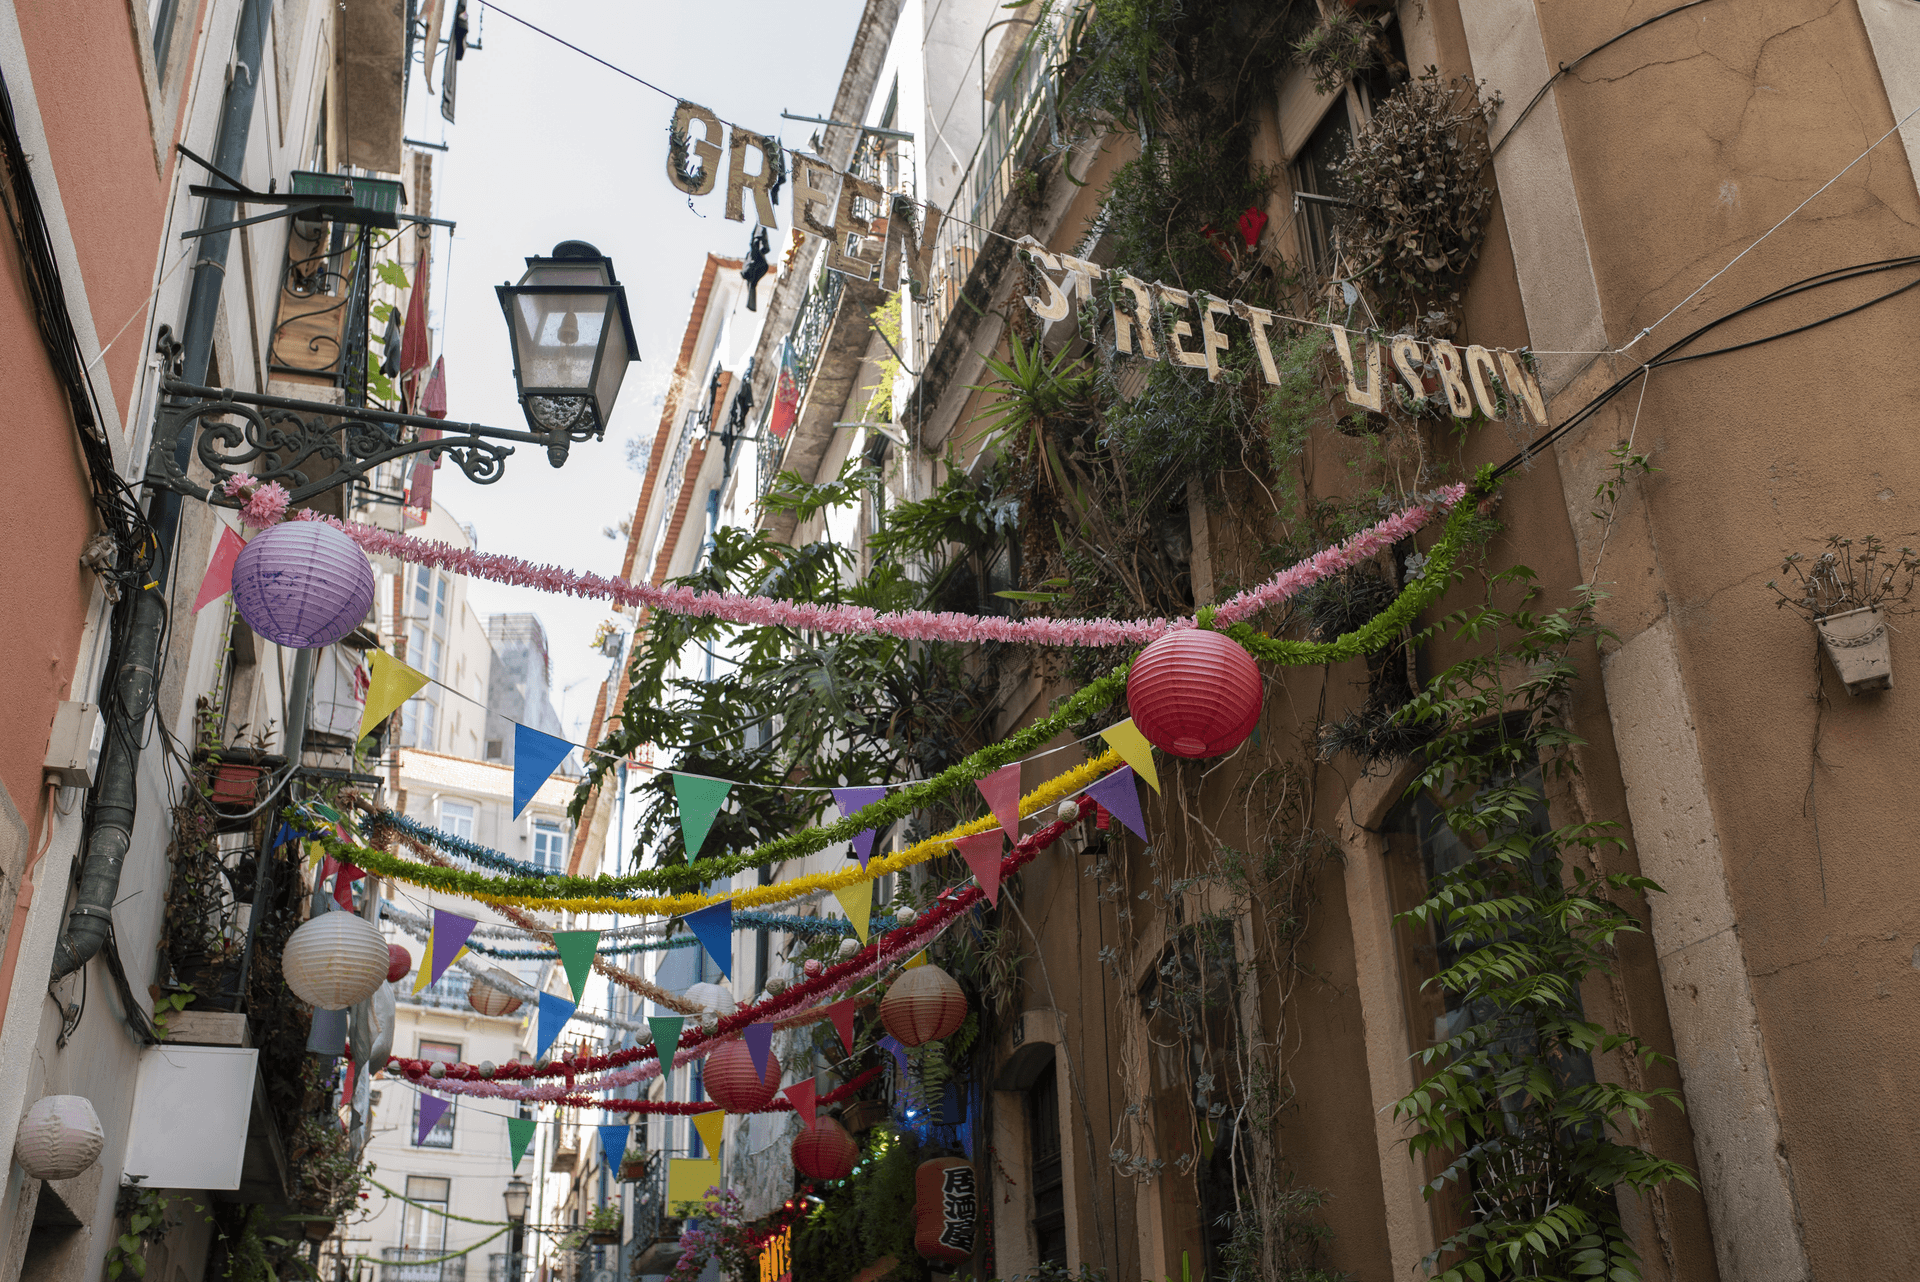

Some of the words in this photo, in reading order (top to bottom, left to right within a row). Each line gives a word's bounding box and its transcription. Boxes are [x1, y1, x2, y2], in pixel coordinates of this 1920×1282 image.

[666, 98, 943, 303] GREEN
[1016, 234, 1281, 386] STREET
[1331, 323, 1549, 427] LISBON
[939, 1166, 977, 1255] 居酒屋
